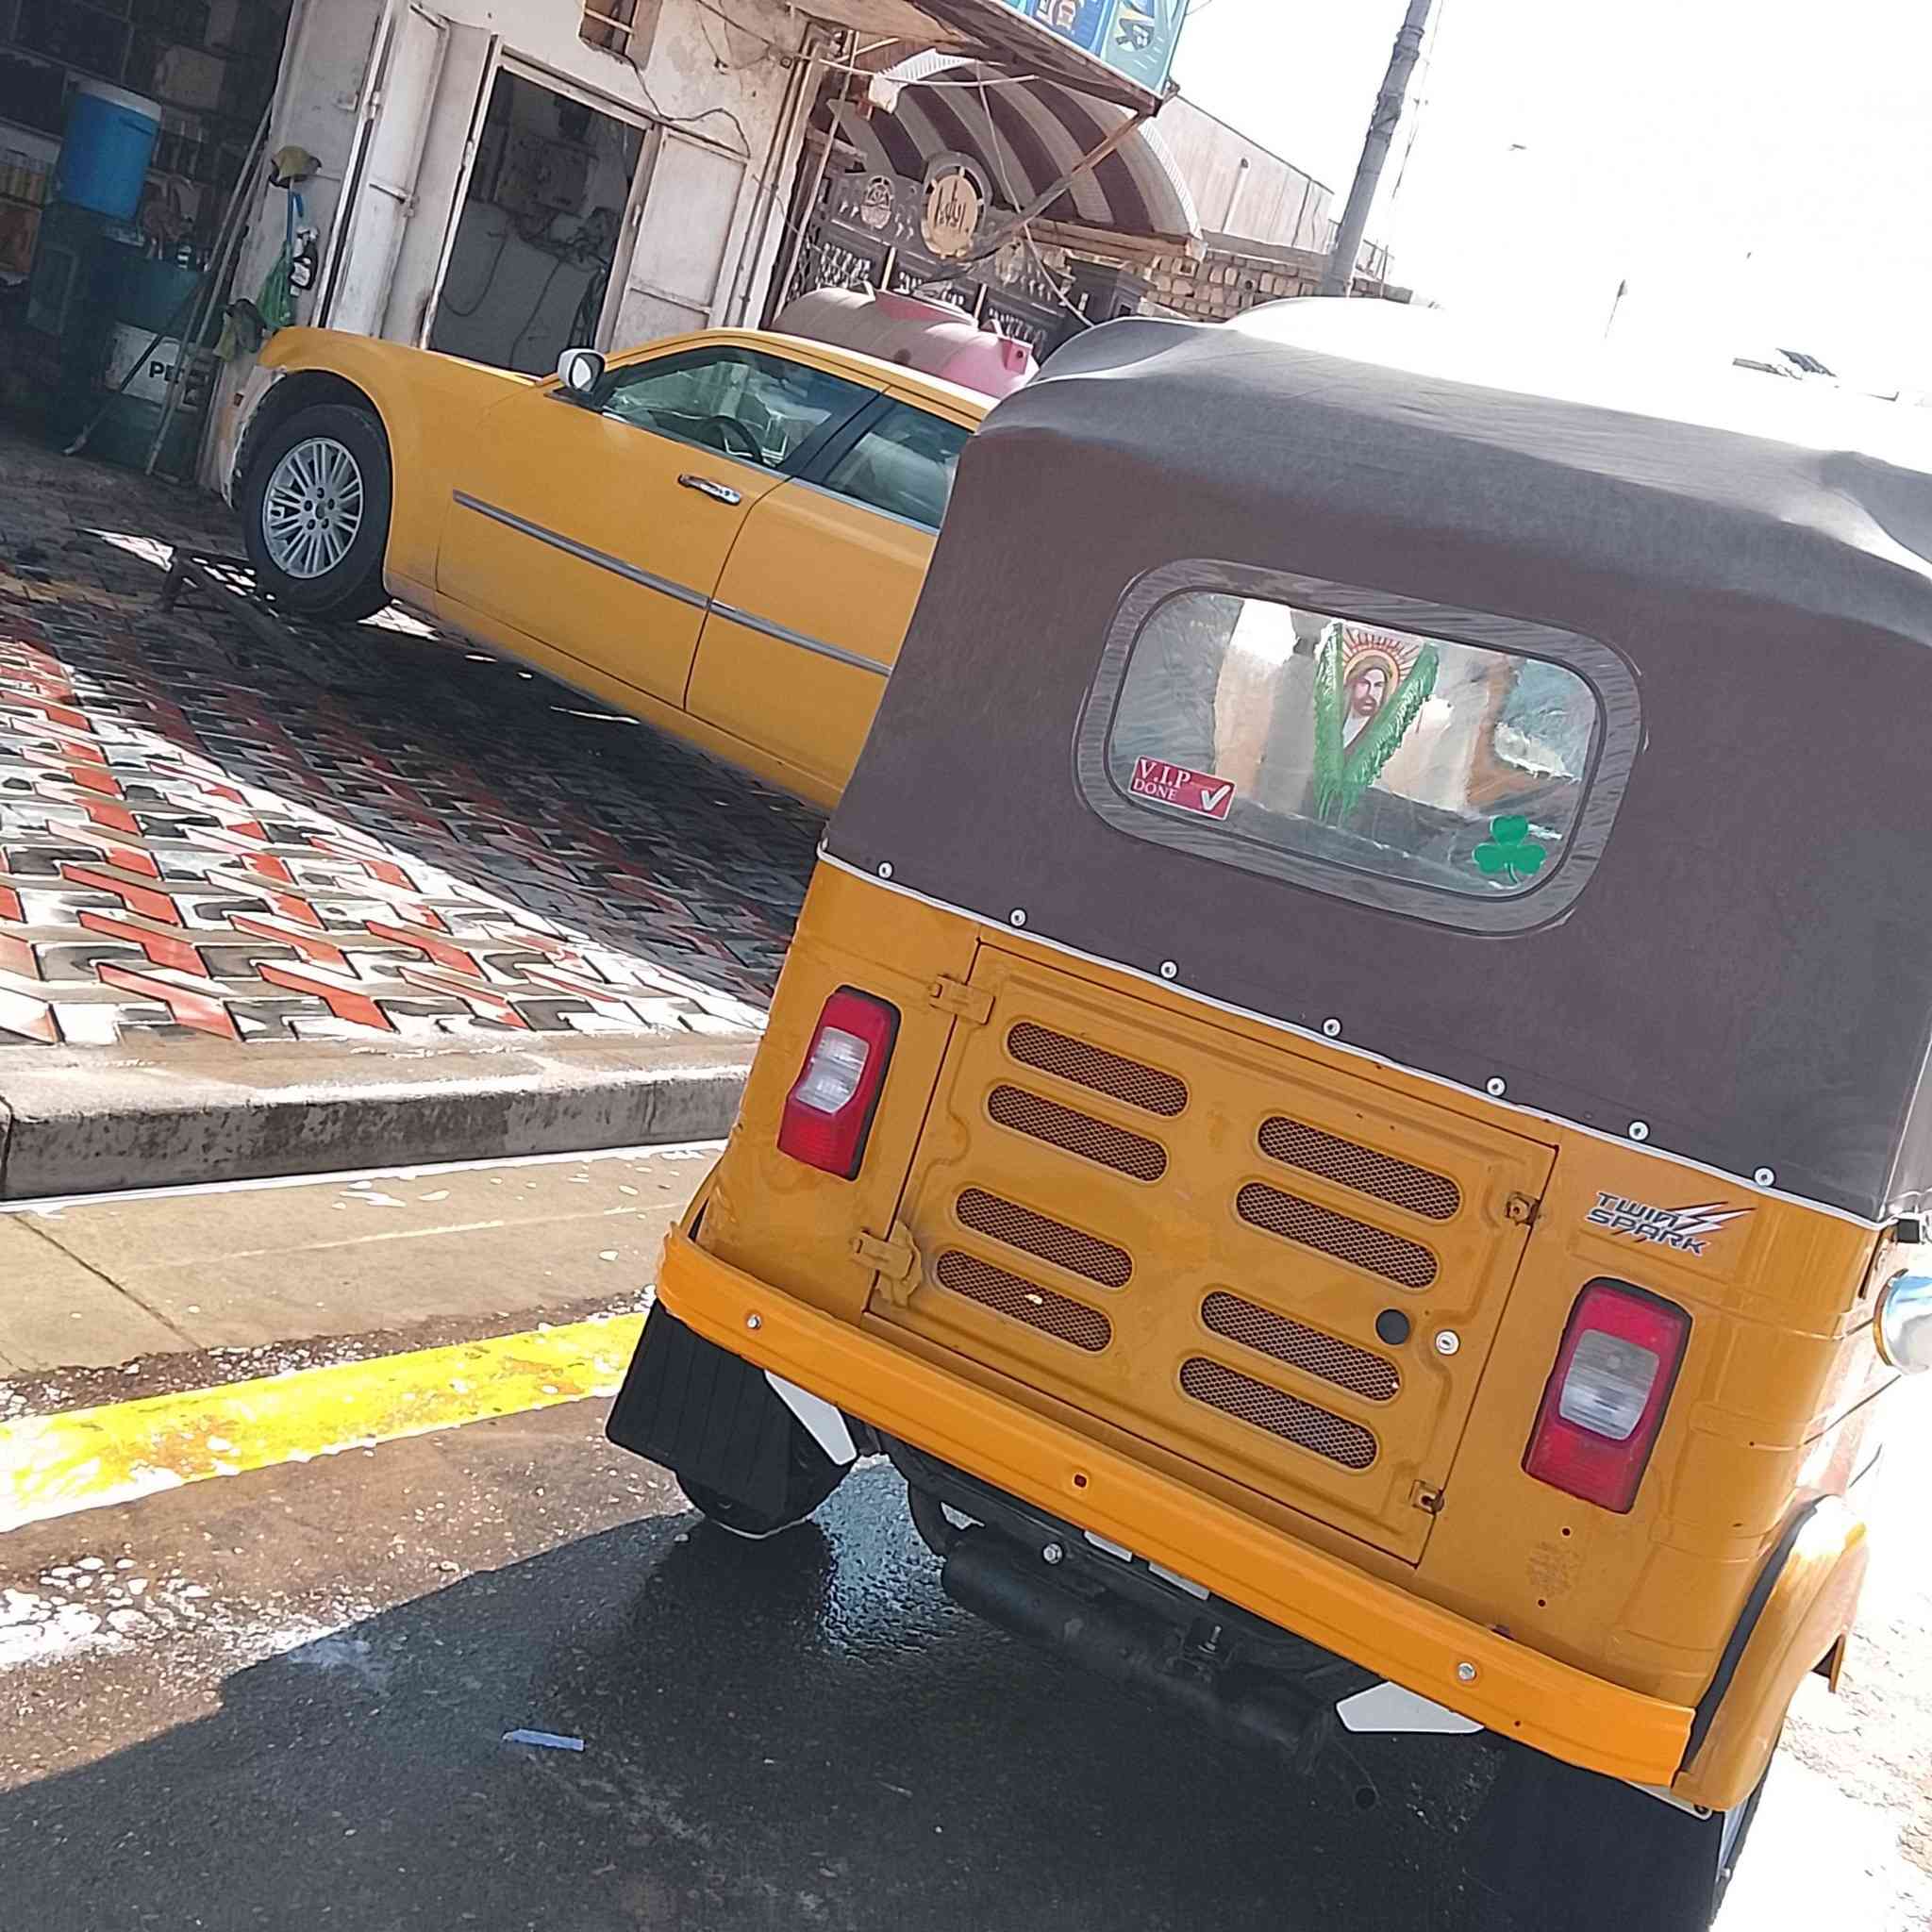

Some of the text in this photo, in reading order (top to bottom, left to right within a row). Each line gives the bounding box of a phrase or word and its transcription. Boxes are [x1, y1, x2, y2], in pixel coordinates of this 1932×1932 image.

[1133, 778, 1178, 801] DONE
[1140, 758, 1191, 789] V.I.P
[1597, 1191, 1680, 1227] TWIN
[1586, 1208, 1708, 1255] SPARK
